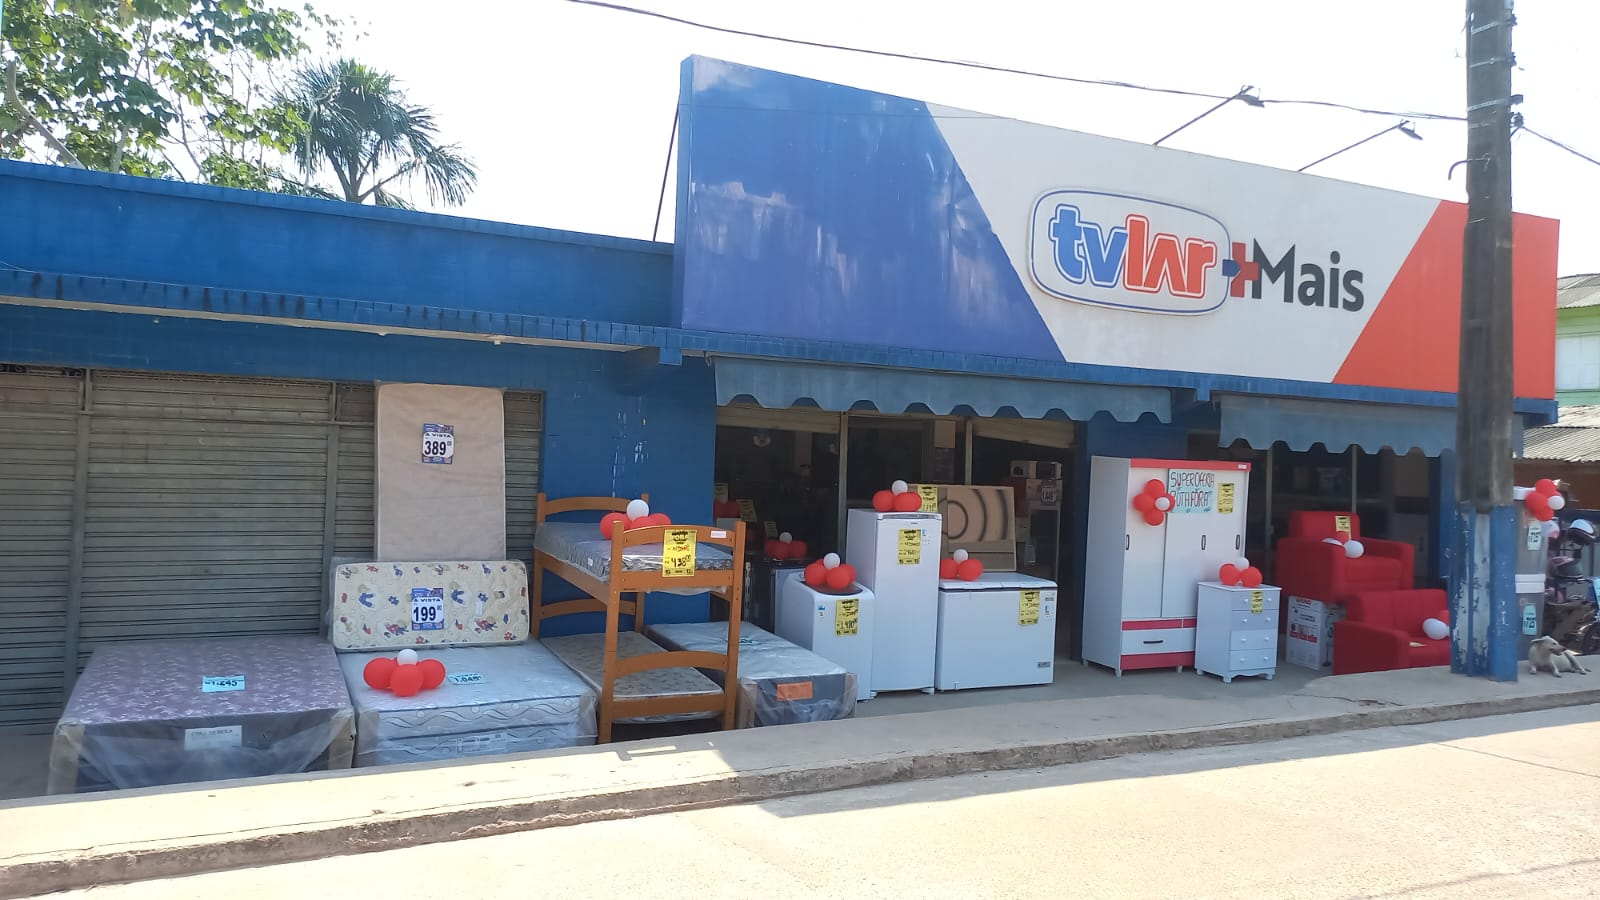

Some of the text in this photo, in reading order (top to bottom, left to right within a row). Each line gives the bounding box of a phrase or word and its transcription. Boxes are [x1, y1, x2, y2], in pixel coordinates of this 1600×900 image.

[1252, 237, 1365, 313] Mais
[424, 440, 447, 456] 389
[413, 606, 437, 622] 199
